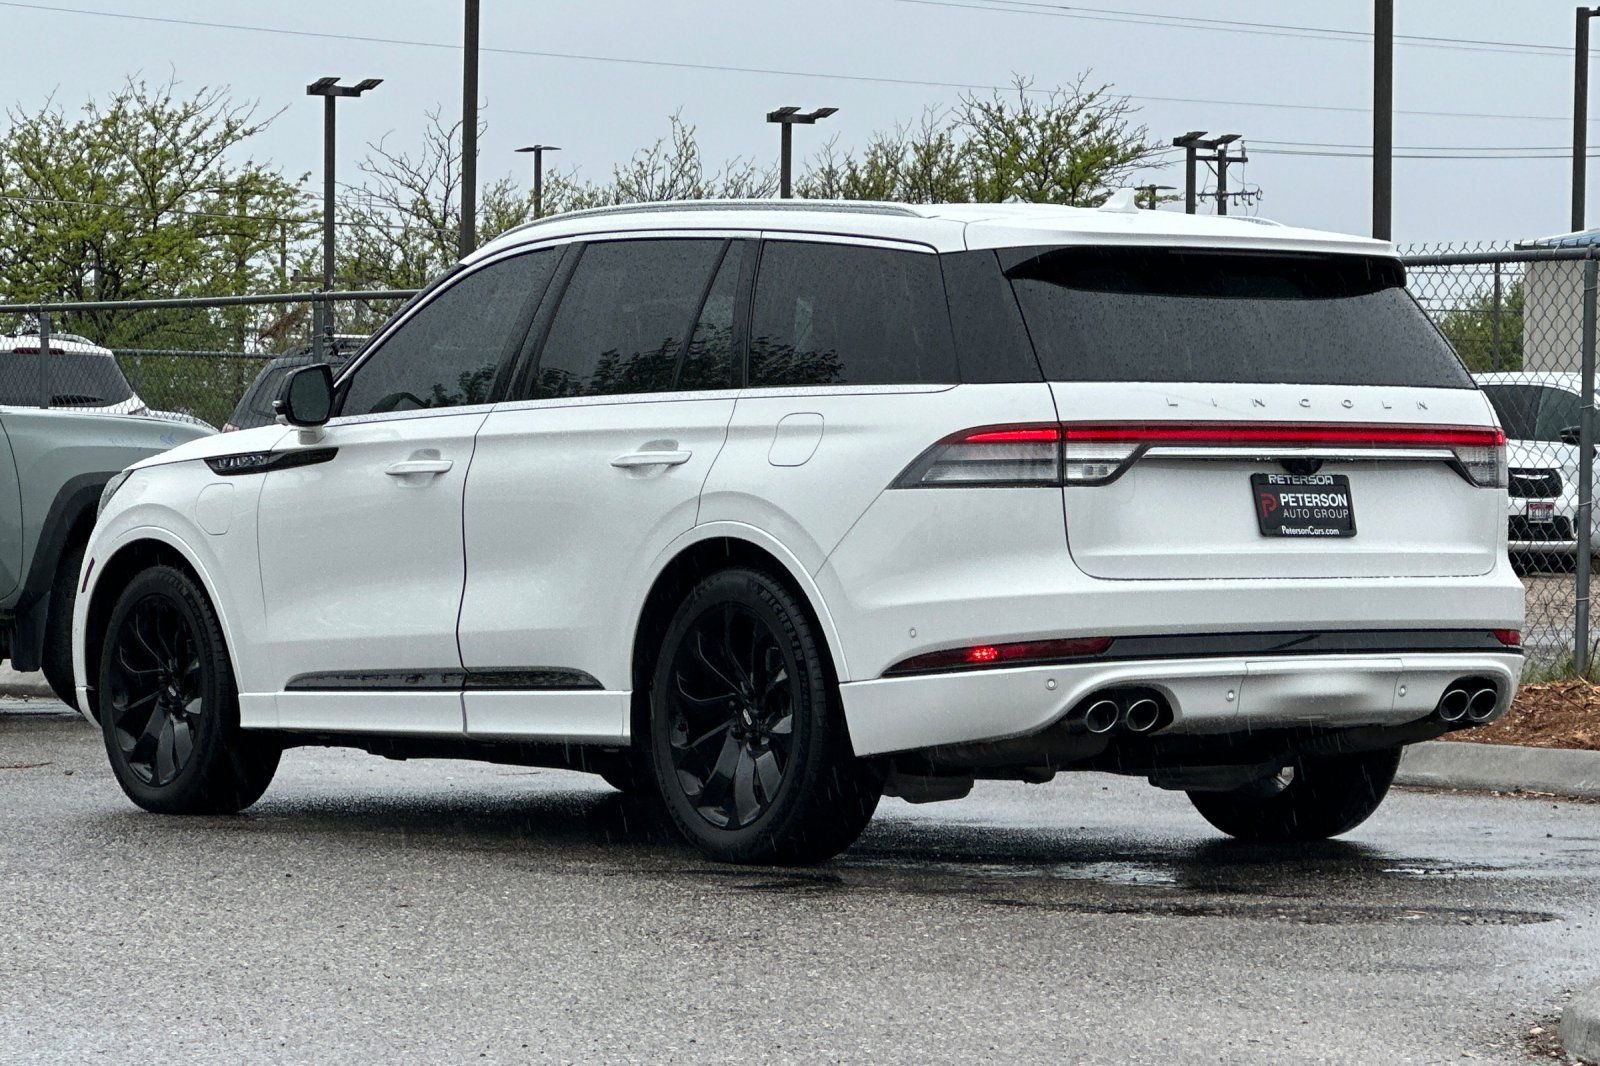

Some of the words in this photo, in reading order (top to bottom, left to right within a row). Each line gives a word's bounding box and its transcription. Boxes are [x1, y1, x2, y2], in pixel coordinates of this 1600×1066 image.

[1165, 397, 1429, 411] LINCOLN
[1280, 493, 1348, 507] PETERSON
[1283, 509, 1309, 519] AUTO
[1314, 509, 1349, 519] GROUP
[1281, 525, 1340, 535] PetersonCars.com
